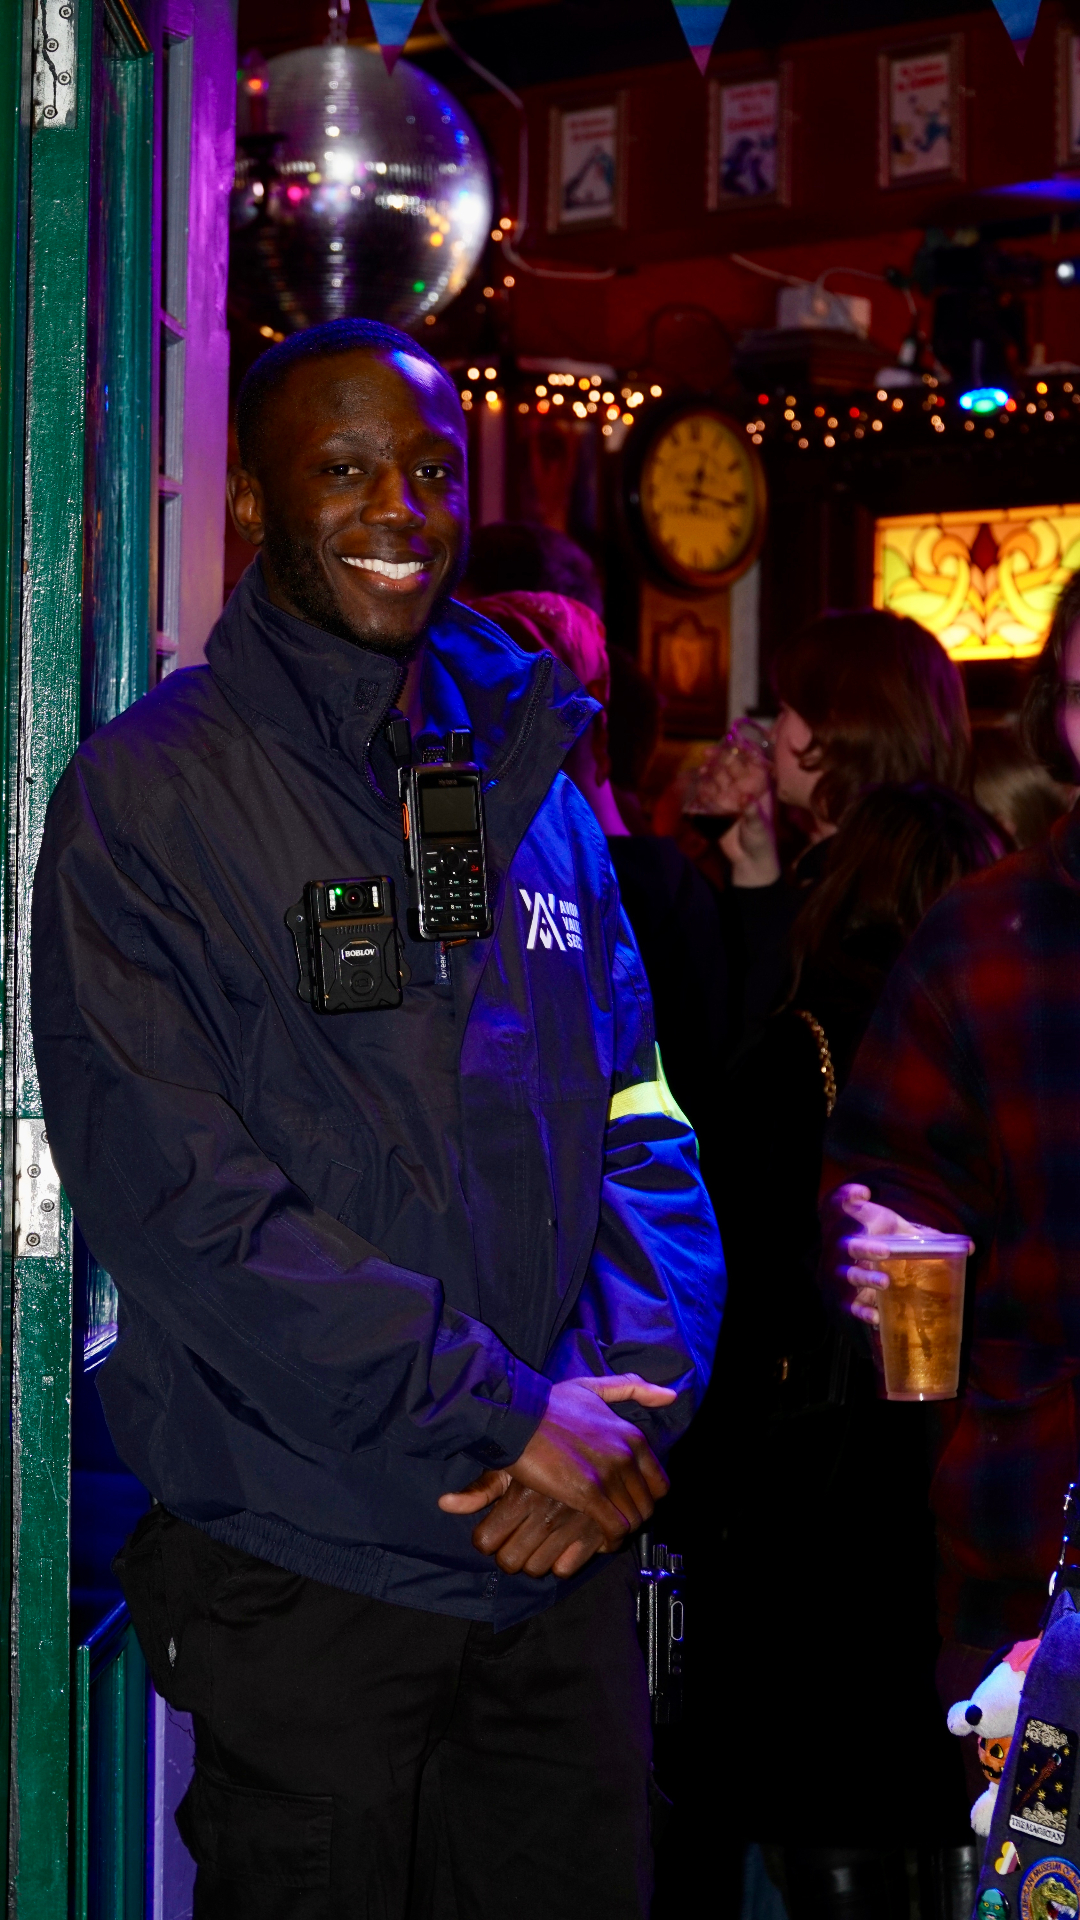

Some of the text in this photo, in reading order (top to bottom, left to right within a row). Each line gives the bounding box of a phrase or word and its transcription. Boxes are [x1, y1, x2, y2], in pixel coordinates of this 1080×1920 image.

[345, 948, 375, 957] BOBLOV
[1026, 1822, 1065, 1841] MAGICIAN
[1022, 1862, 1073, 1920] MERICAN MUSEUM OF
